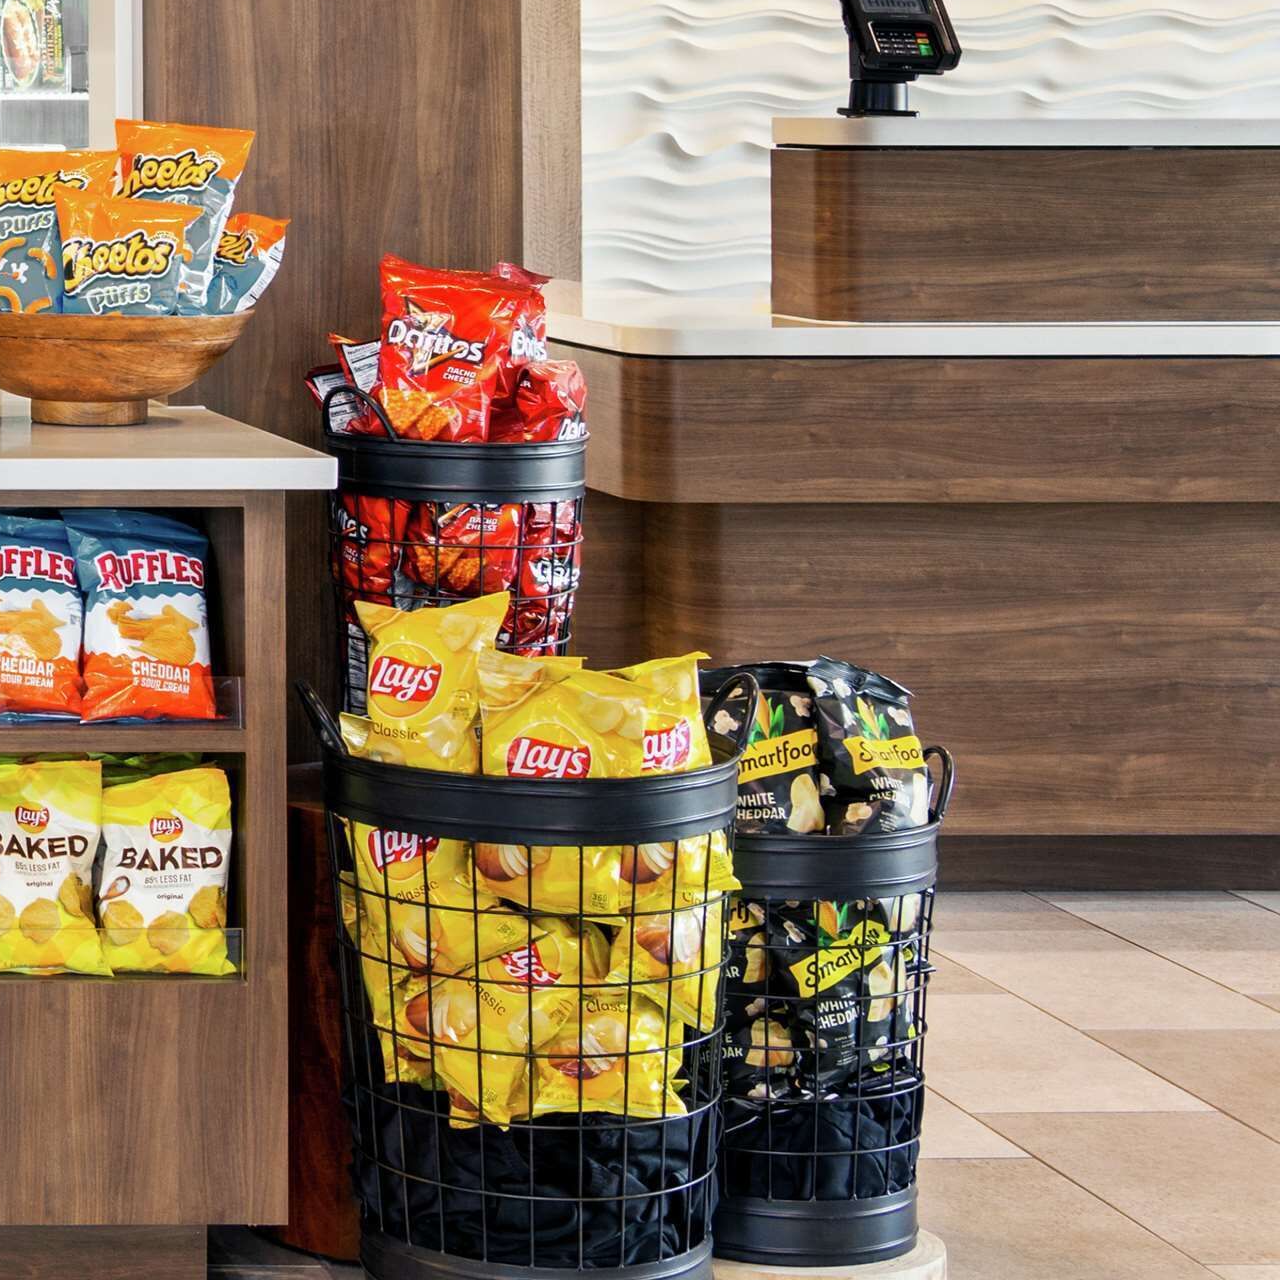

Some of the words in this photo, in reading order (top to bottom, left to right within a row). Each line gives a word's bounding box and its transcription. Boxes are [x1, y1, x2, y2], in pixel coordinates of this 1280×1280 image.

[120, 151, 218, 198] heetos
[63, 232, 175, 296] Cheetos
[388, 319, 484, 363] Doritos
[442, 373, 476, 384] CHEESE
[447, 366, 477, 378] NACHO
[97, 550, 203, 591] RUFFLES
[131, 660, 191, 682] CHEDDAR
[371, 656, 433, 701] Lay's
[1, 675, 22, 686] SOUR
[25, 676, 54, 689] CREAM
[133, 678, 139, 686] &
[141, 679, 160, 689] SOUR
[162, 682, 190, 694] CREAM
[372, 722, 419, 741] Classic
[510, 737, 588, 778] Lay's
[738, 792, 776, 807] WHITE
[17, 806, 49, 827] Lay's
[737, 807, 786, 820] HEDDAR
[152, 817, 182, 835] Lay's
[29, 862, 46, 871] LESS
[48, 861, 61, 870] FAT
[118, 846, 223, 871] BAKED
[26, 880, 53, 888] original
[160, 875, 178, 884] LESS
[180, 874, 192, 883] FAT
[157, 893, 184, 901] original
